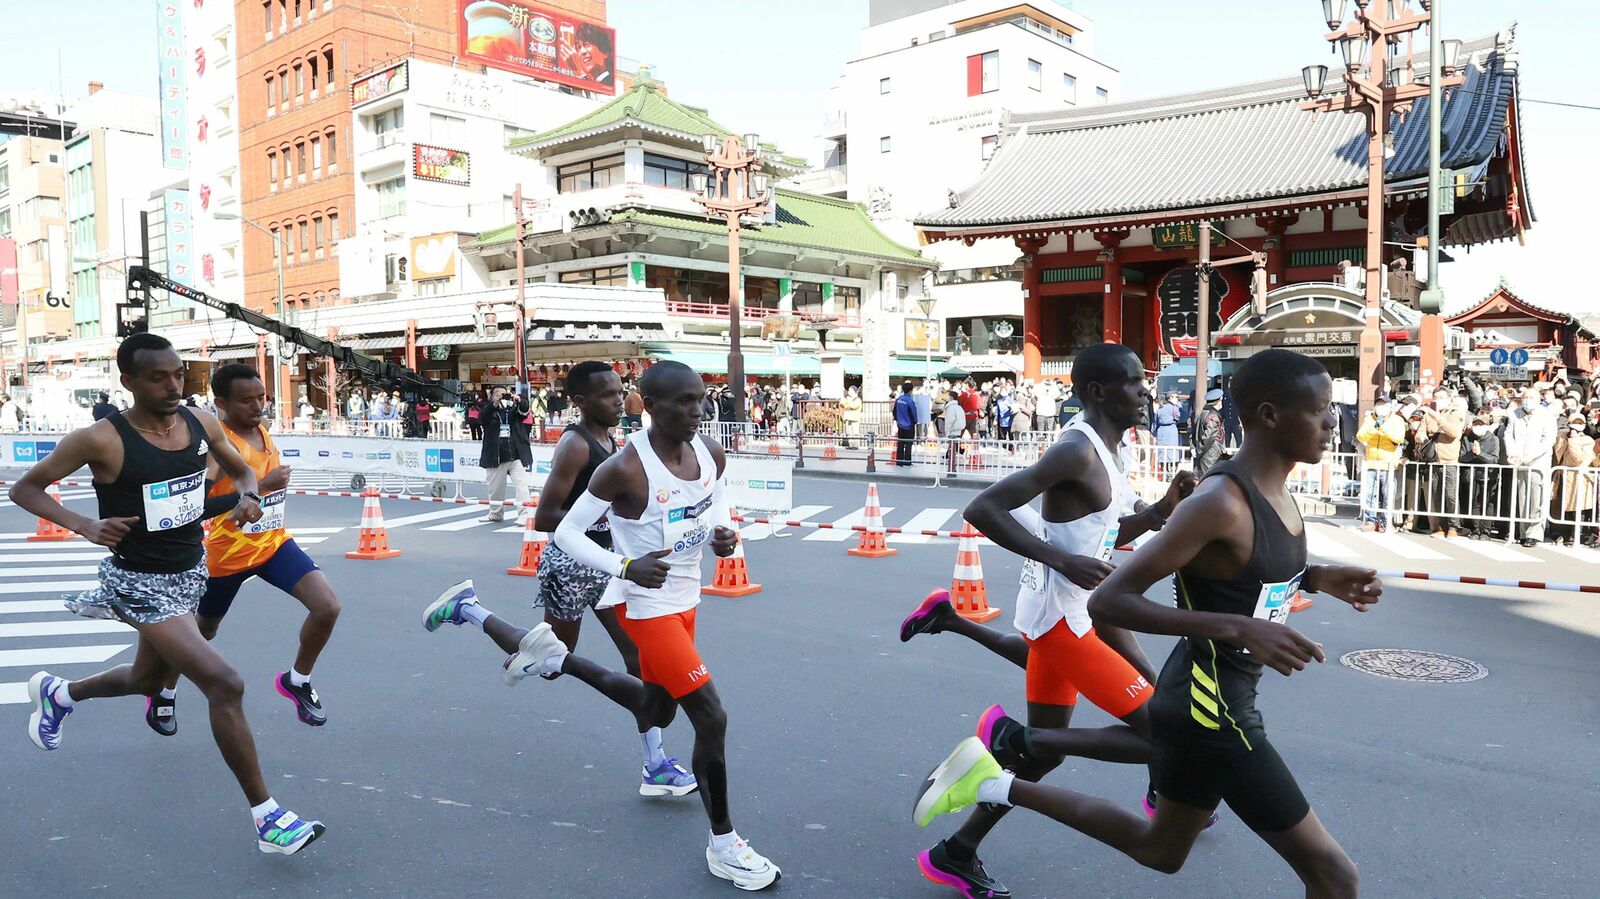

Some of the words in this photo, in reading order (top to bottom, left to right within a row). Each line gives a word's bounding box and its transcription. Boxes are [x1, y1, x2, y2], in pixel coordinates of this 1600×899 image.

[509, 3, 529, 28] 新
[173, 201, 186, 276] カラオケ
[1304, 331, 1352, 343] 雷門交番
[1327, 347, 1351, 355] KOBAN
[181, 493, 188, 504] 5
[178, 503, 193, 513] TOLA
